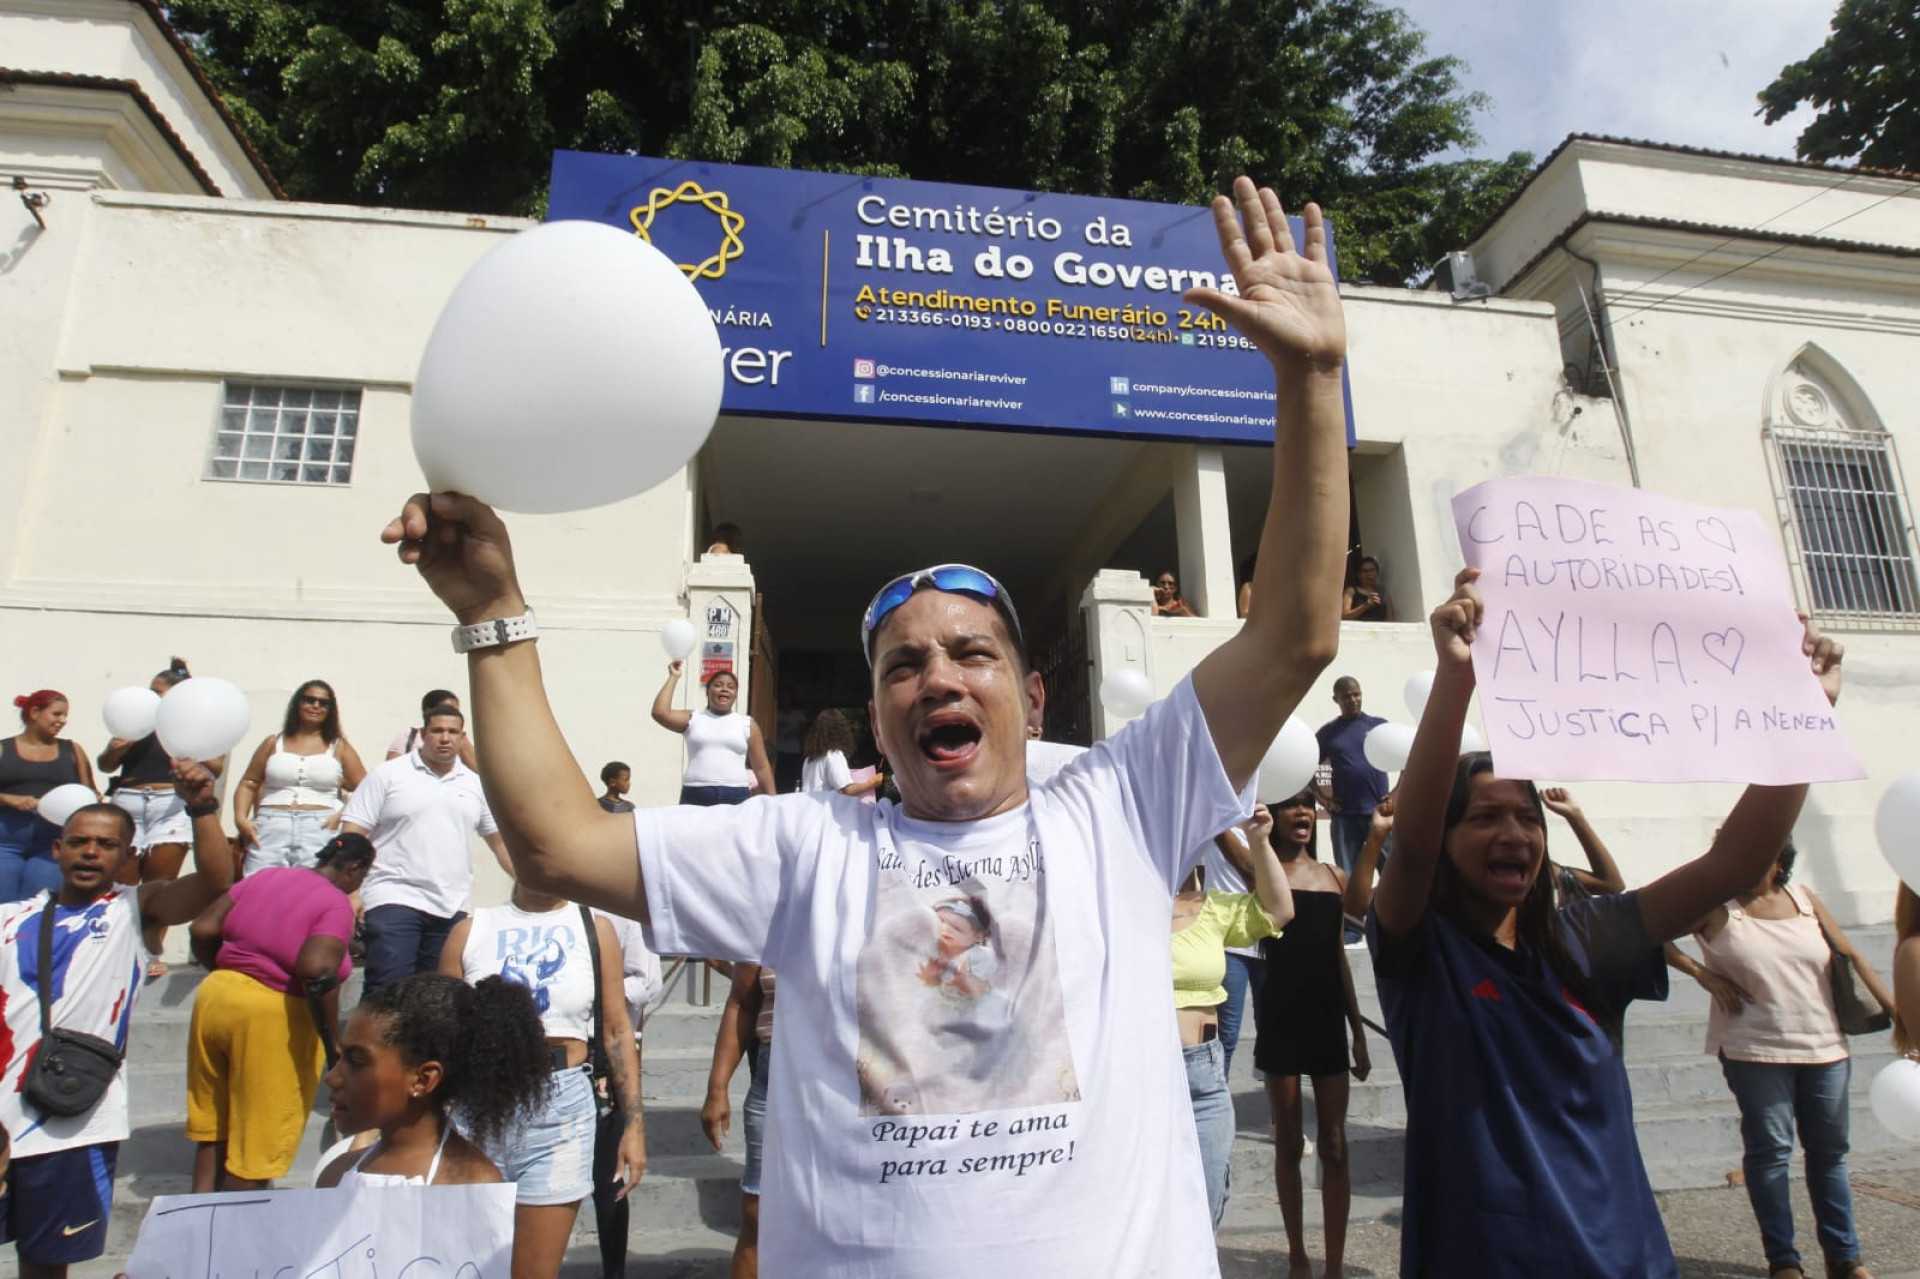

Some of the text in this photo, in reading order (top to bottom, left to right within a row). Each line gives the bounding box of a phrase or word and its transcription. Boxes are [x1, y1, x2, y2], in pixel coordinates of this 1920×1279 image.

[856, 194, 1132, 247] Cemitério da
[855, 233, 953, 274] Ilha
[974, 245, 1034, 279] do
[855, 284, 1227, 332] Atendimento Funerário 24h
[876, 365, 1028, 385] @concessionariareviver
[878, 390, 1024, 410] /concessionariareviver
[1467, 500, 1681, 552] CADE AS
[496, 923, 577, 961] RIO
[871, 1112, 1069, 1149] Papai te ama
[878, 1140, 1076, 1184] para sempre!
